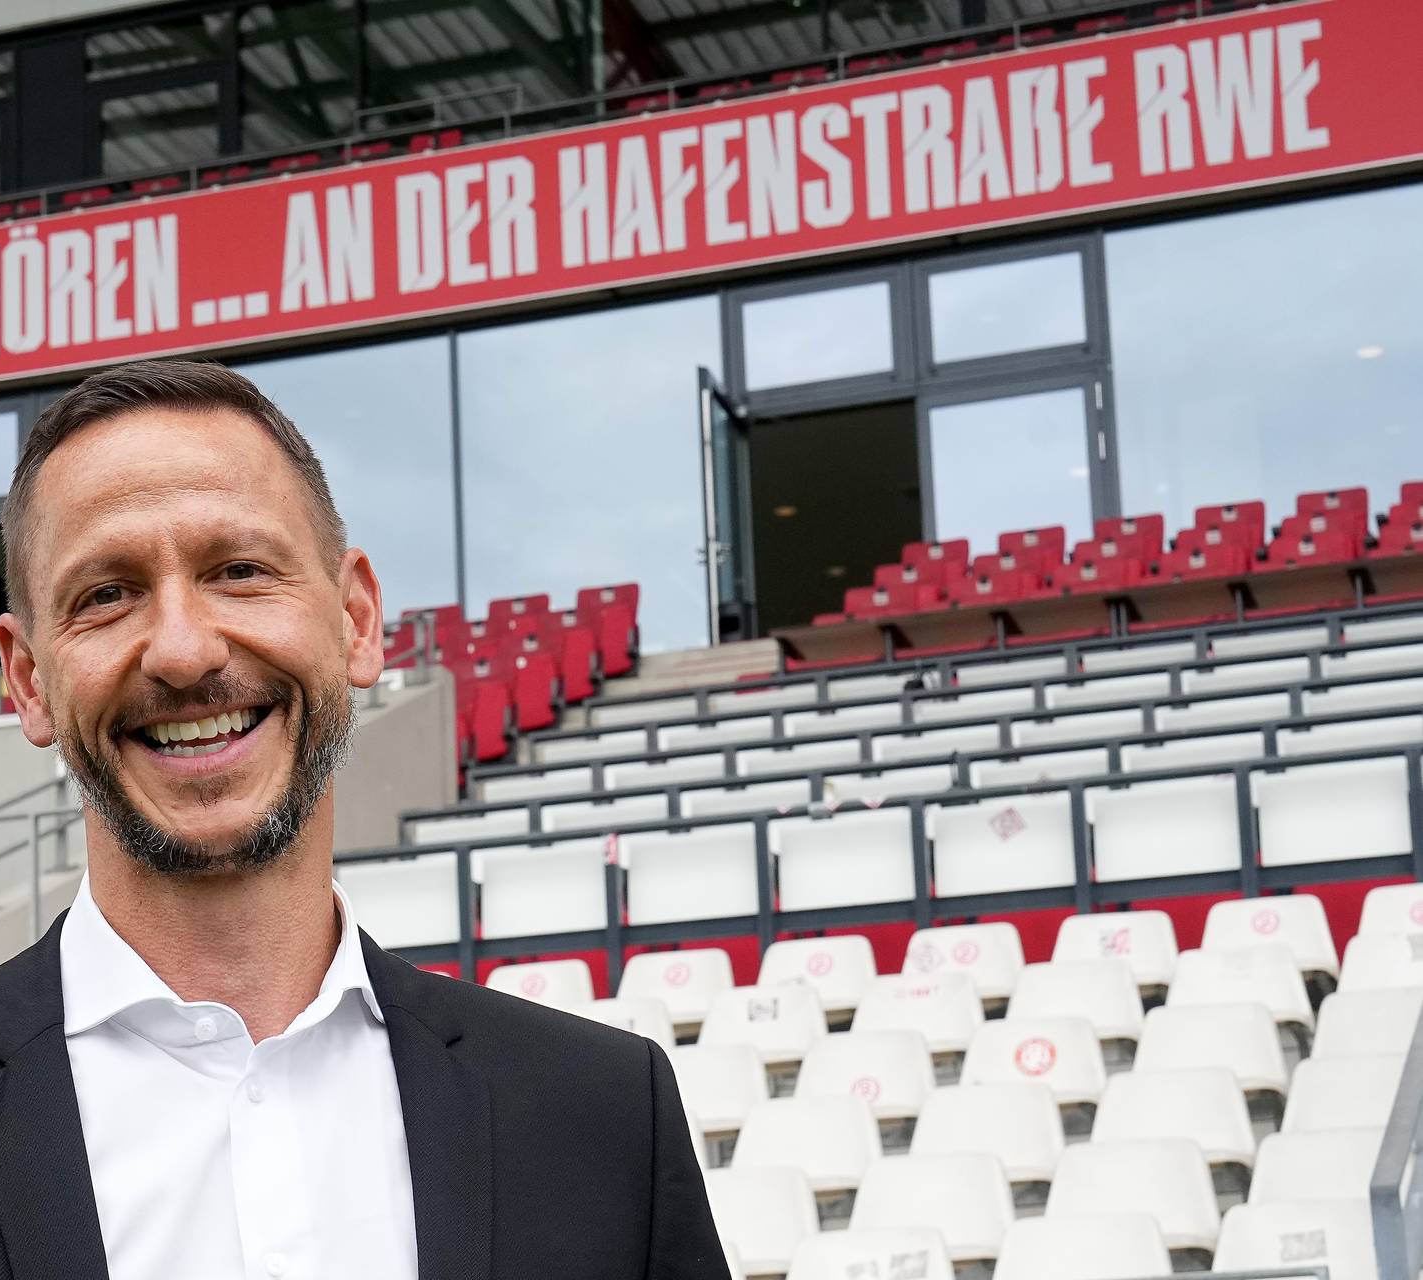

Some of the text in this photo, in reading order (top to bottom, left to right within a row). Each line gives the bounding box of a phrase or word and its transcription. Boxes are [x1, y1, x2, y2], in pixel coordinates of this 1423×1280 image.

[280, 182, 374, 313] AN
[396, 156, 537, 294] DER
[1134, 20, 1329, 176] RWE
